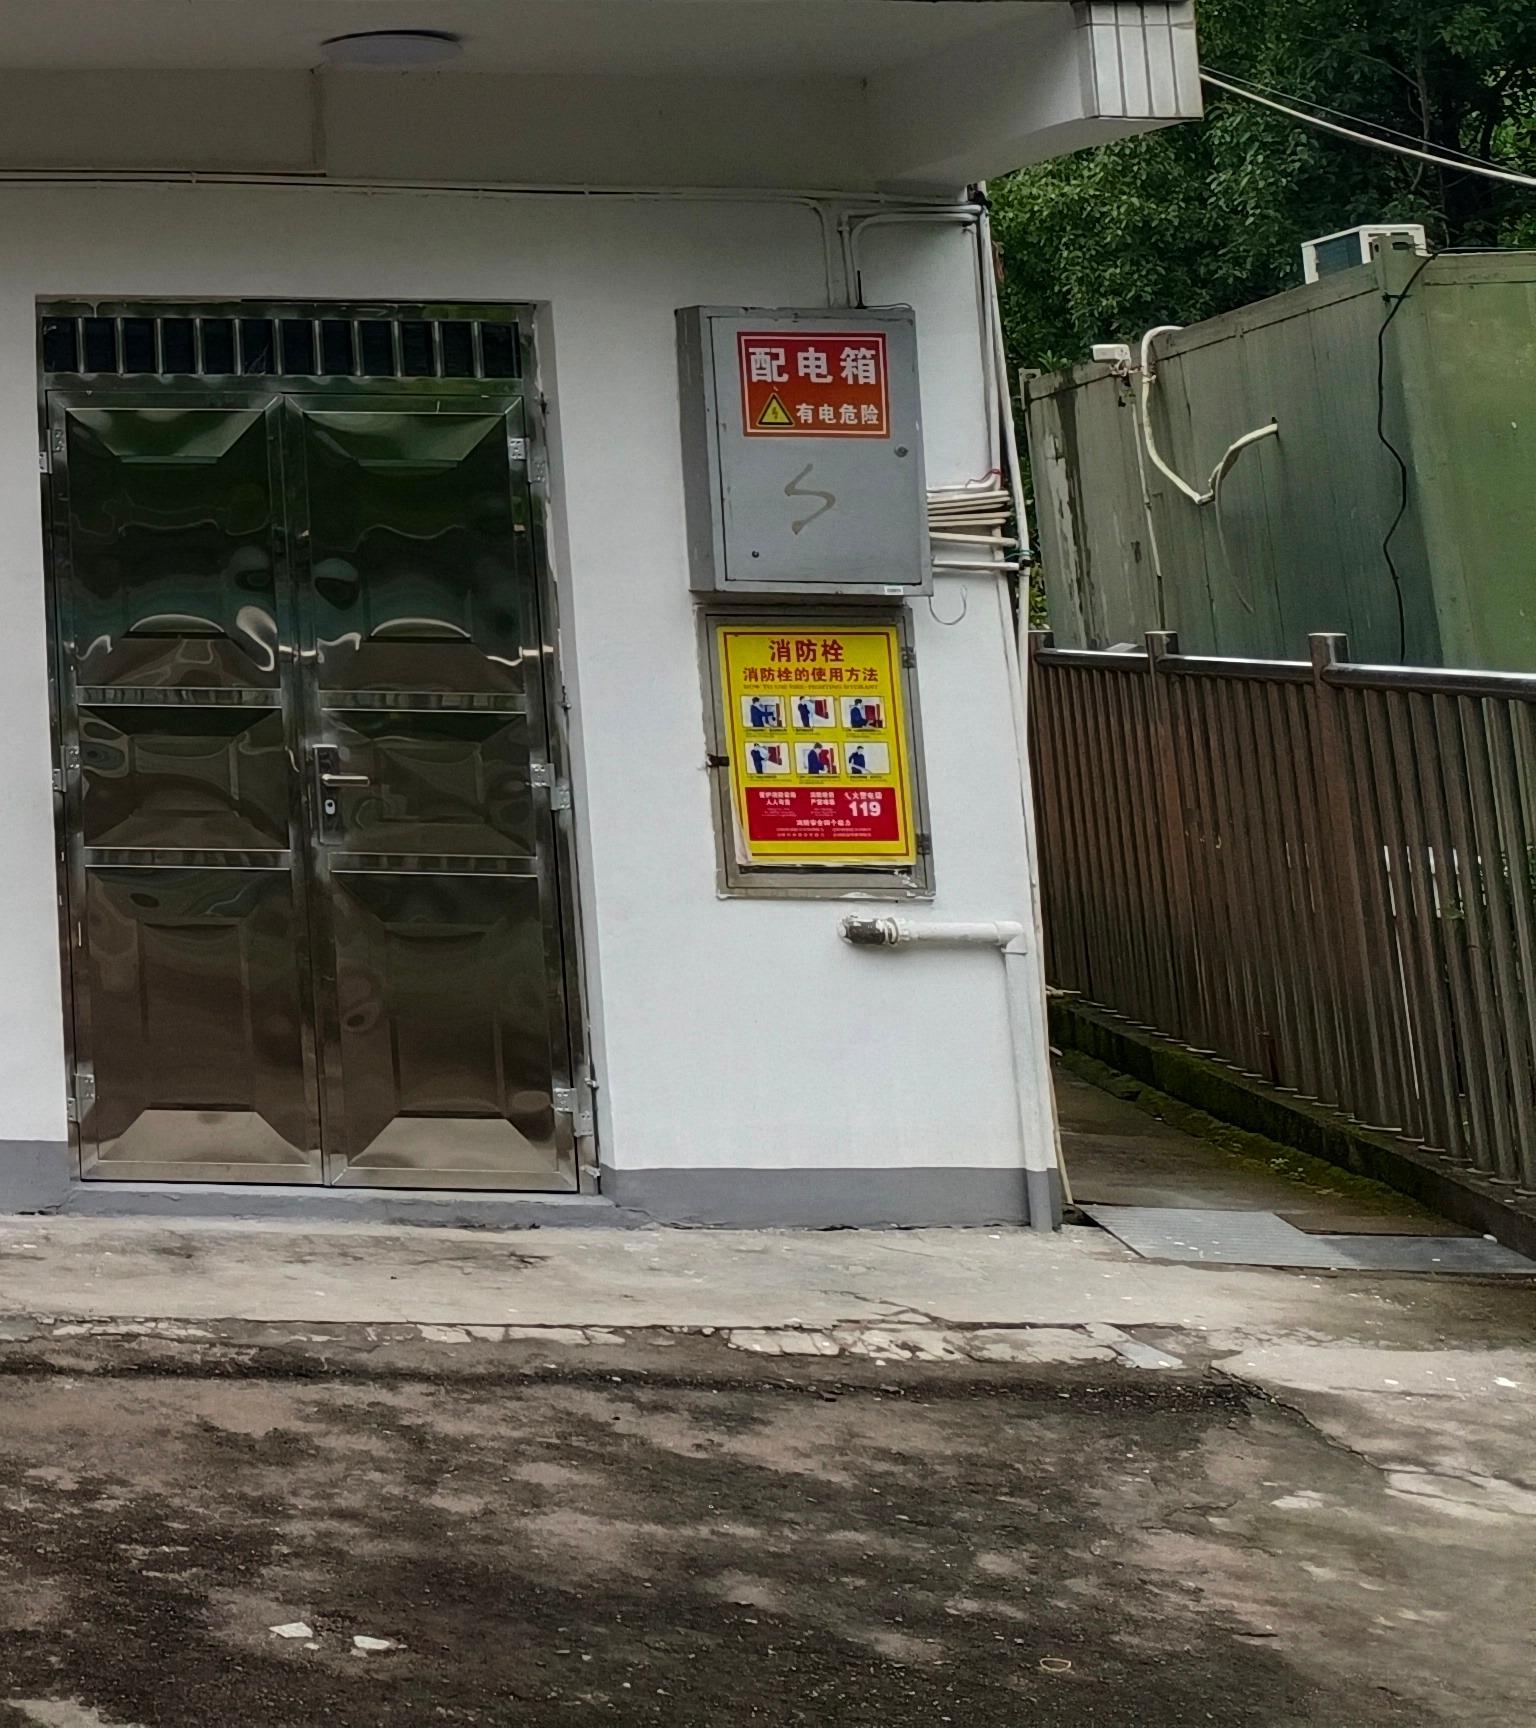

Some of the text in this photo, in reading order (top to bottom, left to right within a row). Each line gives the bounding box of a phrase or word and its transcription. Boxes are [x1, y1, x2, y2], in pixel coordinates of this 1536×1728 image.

[748, 347, 877, 385] 配电箱
[795, 403, 880, 424] 有电危险
[768, 638, 845, 663] 消防栓
[743, 667, 879, 683] 消防栓的使用方法
[849, 801, 882, 817] 119
